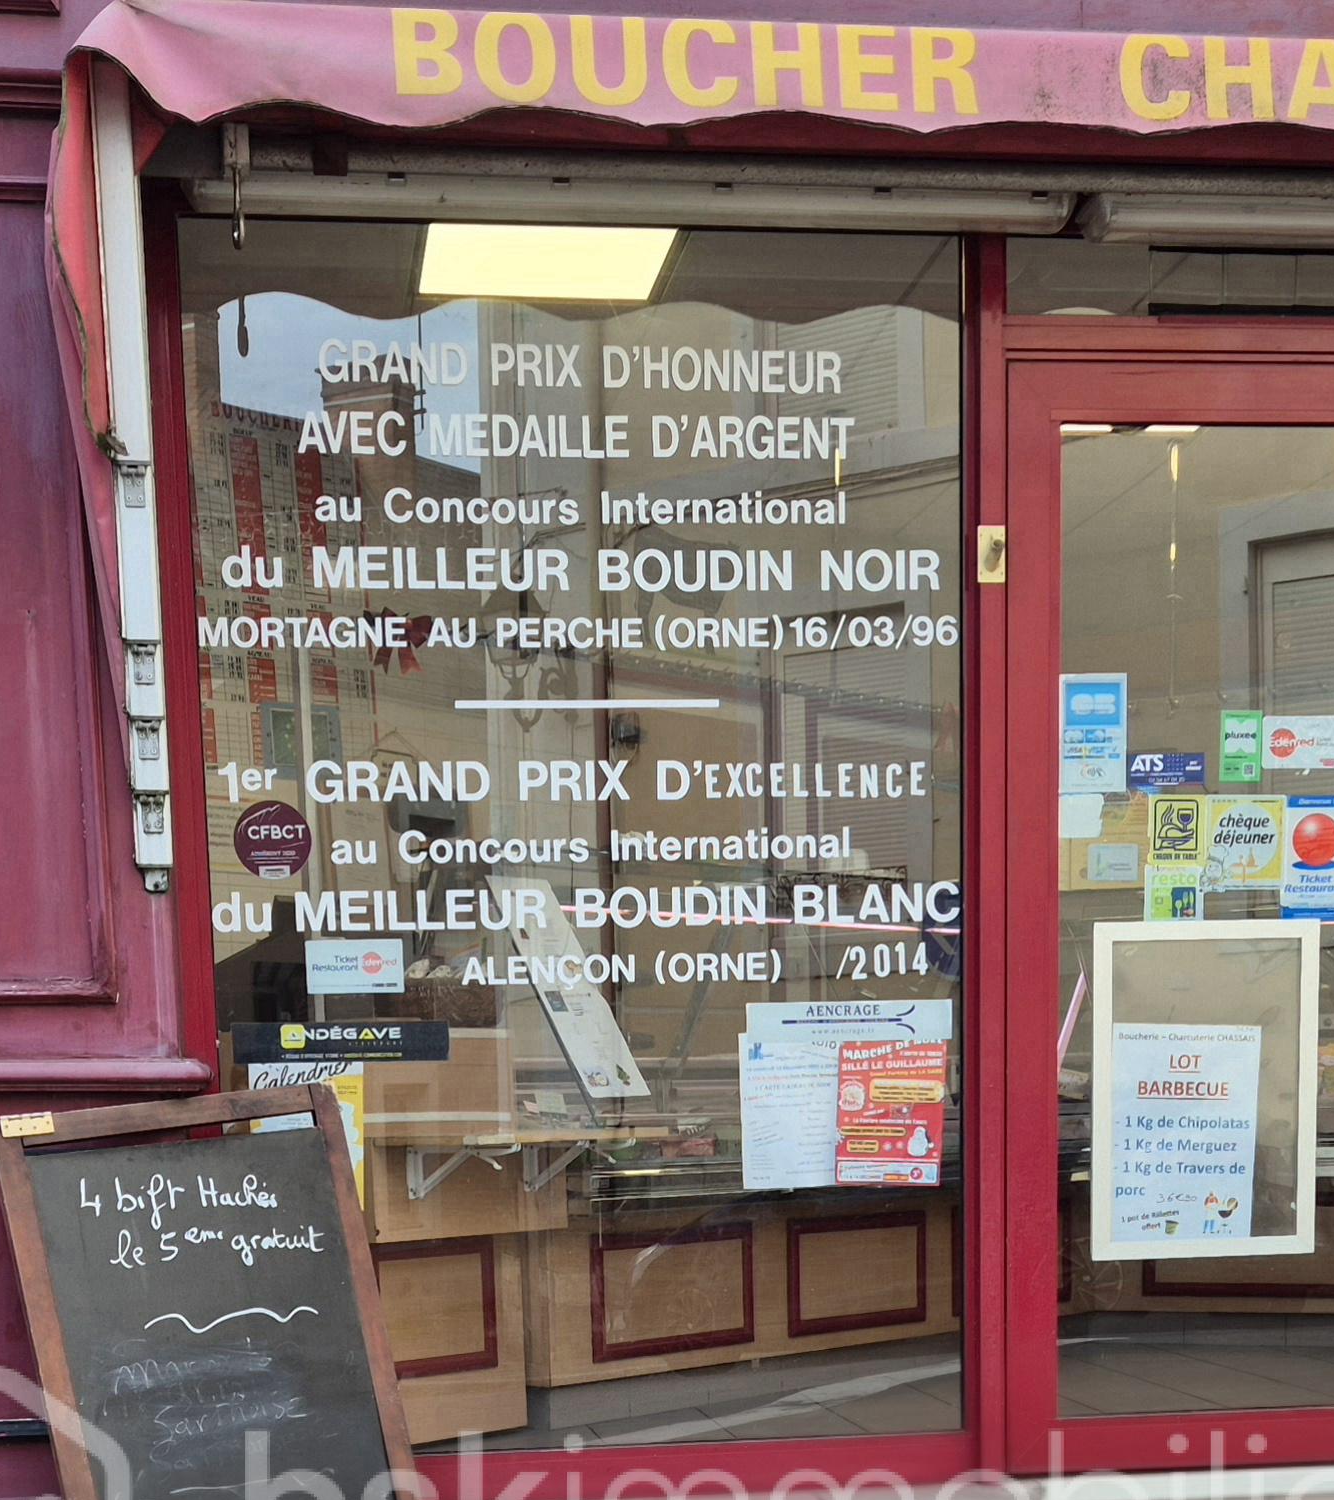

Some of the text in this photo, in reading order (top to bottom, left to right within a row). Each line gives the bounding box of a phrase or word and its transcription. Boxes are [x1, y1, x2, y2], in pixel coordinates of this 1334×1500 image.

[391, 7, 980, 116] BOUCHER
[319, 338, 842, 395] GRAND PRIX D'HONNEUR
[298, 410, 854, 460] AVEC MEDAILLE D'ARGENT
[315, 487, 846, 525] au Concours International
[221, 545, 940, 592] du MEILLEUR BOUDIN NOIR
[198, 613, 958, 651] MORTAGNE AU PERCHE (ORNE) 16/03/96
[1131, 754, 1164, 772] ATS
[218, 760, 926, 802] 1er GRAND PRIX D'EXCELLENCE
[1219, 813, 1269, 832] chèque
[247, 824, 306, 841] CFBCT
[1214, 830, 1276, 846] déjeuner
[330, 827, 850, 864] au Concours International
[1299, 874, 1333, 884] Ticket
[212, 880, 960, 933] du MEILLEUR BOUDIN BLANC
[334, 955, 358, 964] Ticket
[462, 942, 928, 989] ALENÇON (ORNE) /2014
[806, 1004, 881, 1017] AENCRAGE
[871, 1061, 884, 1070] LE
[885, 1058, 943, 1069] GUILLAUME
[1169, 1054, 1202, 1071] LOT
[253, 1060, 354, 1091] Calendrier
[1138, 1081, 1229, 1098] BARBECUE
[1125, 1116, 1131, 1128] 1
[1137, 1116, 1154, 1131] Kg
[1158, 1116, 1174, 1129] de
[1178, 1116, 1250, 1132] Chipolatas
[1124, 1138, 1130, 1151] 1
[1136, 1138, 1152, 1154] Kg
[1157, 1139, 1173, 1151] de
[1178, 1139, 1237, 1154] Merguez
[1123, 1161, 1129, 1174] 1
[1135, 1161, 1151, 1178] Kg
[1156, 1161, 1172, 1174] de
[1178, 1162, 1225, 1175] Travers
[1229, 1162, 1246, 1175] de
[79, 1178, 100, 1214] 4
[1115, 1186, 1145, 1199] porc
[110, 1230, 146, 1269] le
[231, 1226, 325, 1267] gratuit
